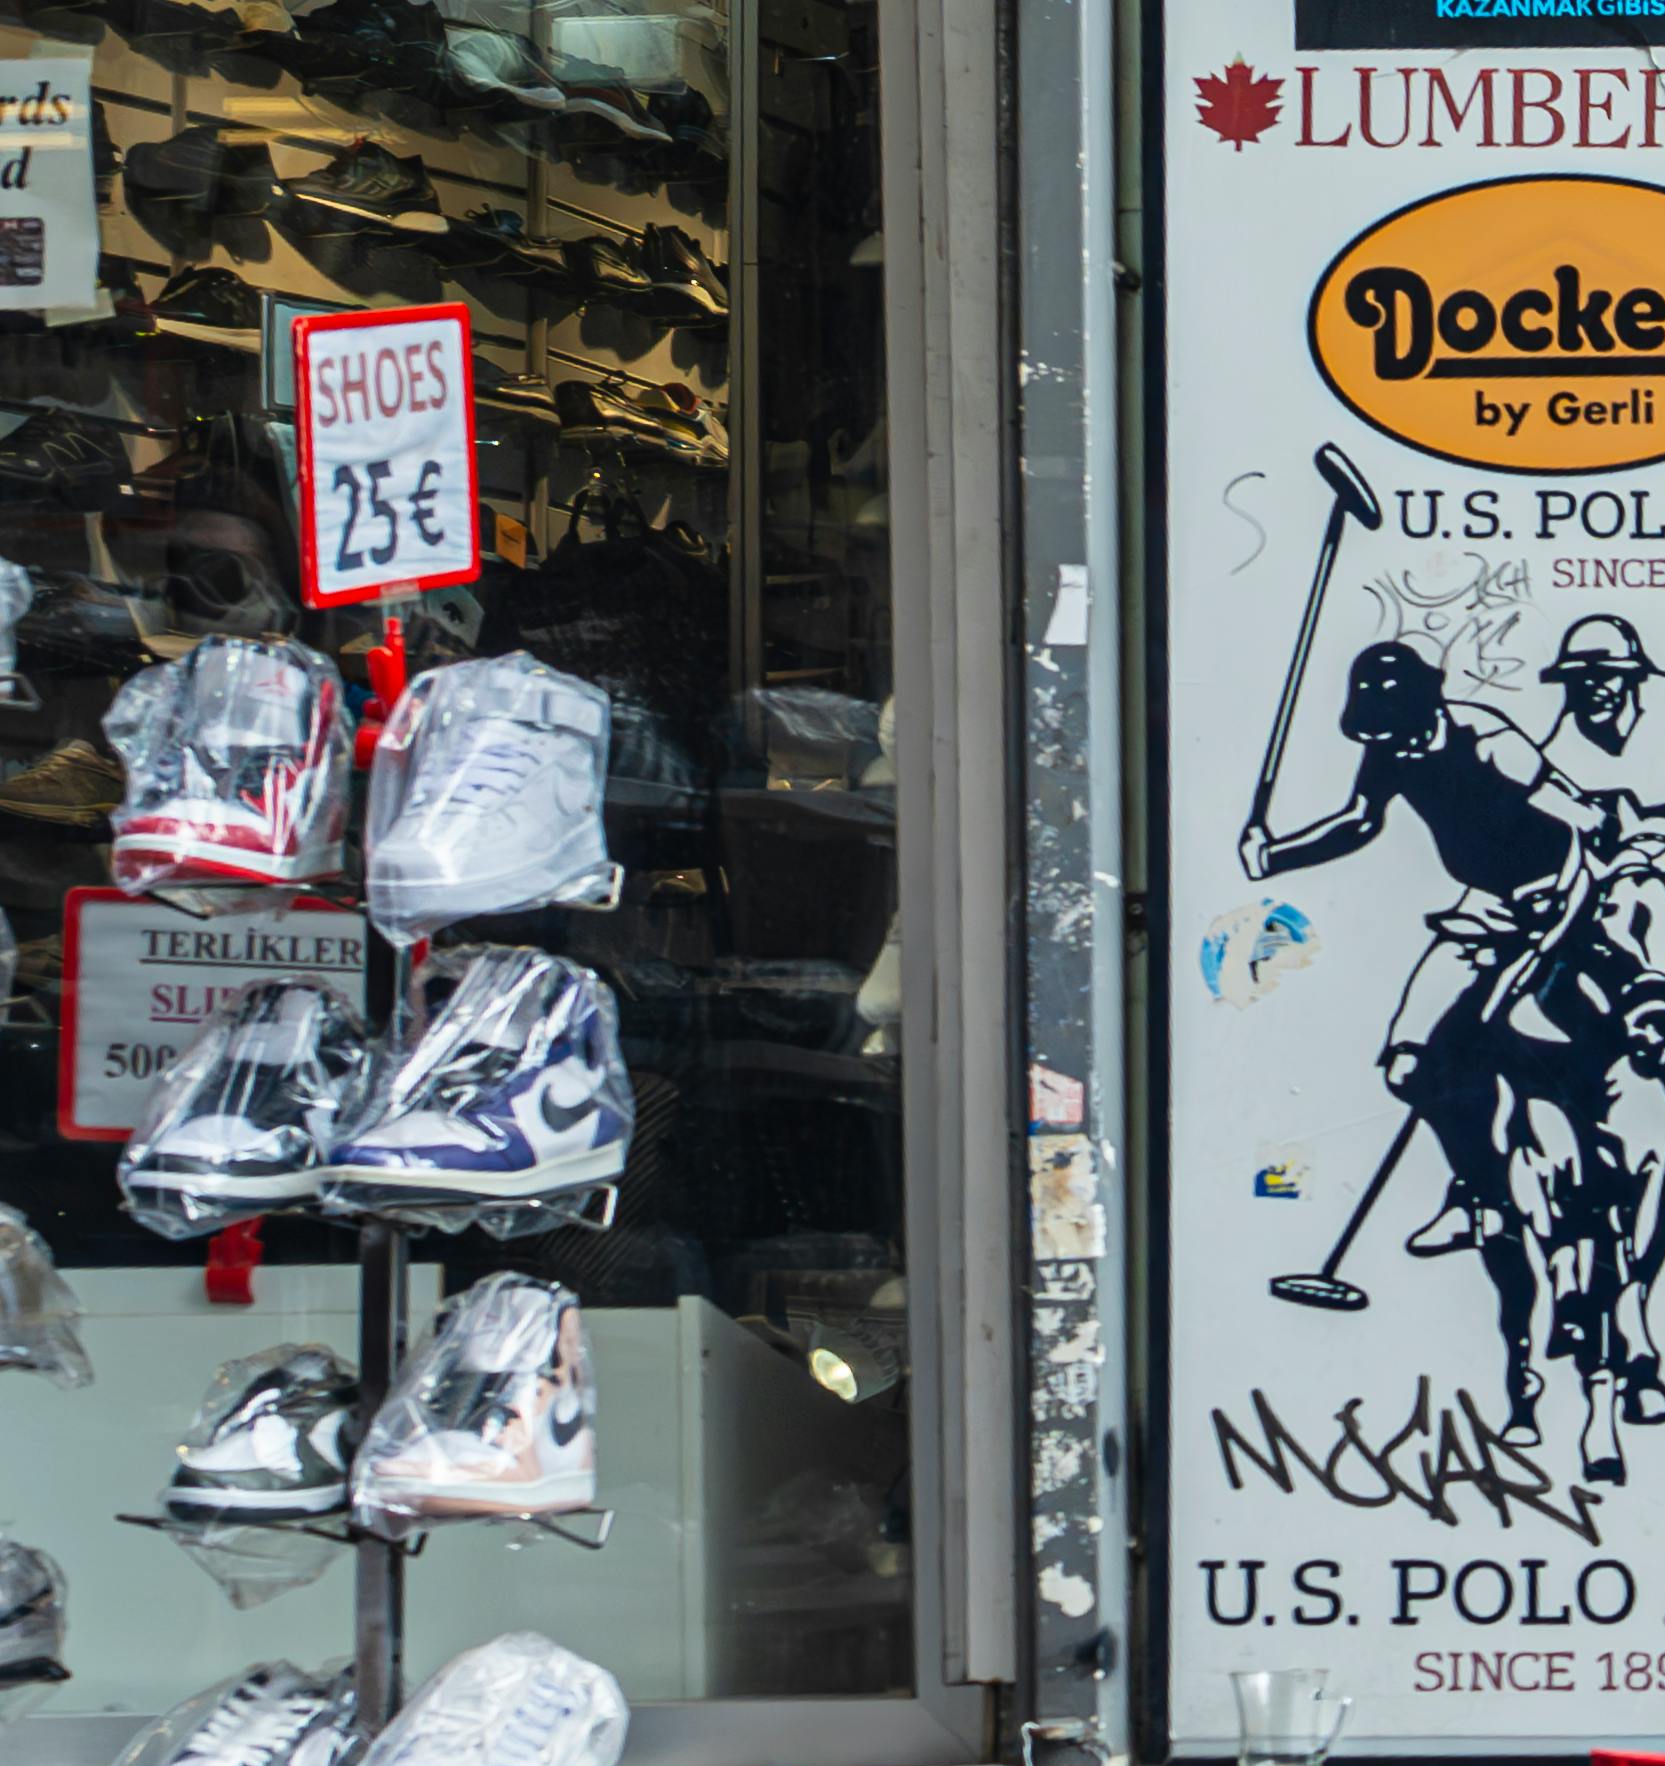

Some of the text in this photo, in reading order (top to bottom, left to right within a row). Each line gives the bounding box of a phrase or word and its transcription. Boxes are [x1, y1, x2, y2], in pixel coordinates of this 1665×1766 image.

[317, 340, 447, 428] SHOES
[1475, 389, 1655, 436] by Gerli
[332, 459, 445, 572] 25€
[1395, 490, 1513, 540] U.S.
[142, 928, 363, 966] TERLİKLER
[1199, 1559, 1360, 1627] U.S.
[1390, 1559, 1637, 1626] POLO
[1414, 1651, 1576, 1692] SINCE
